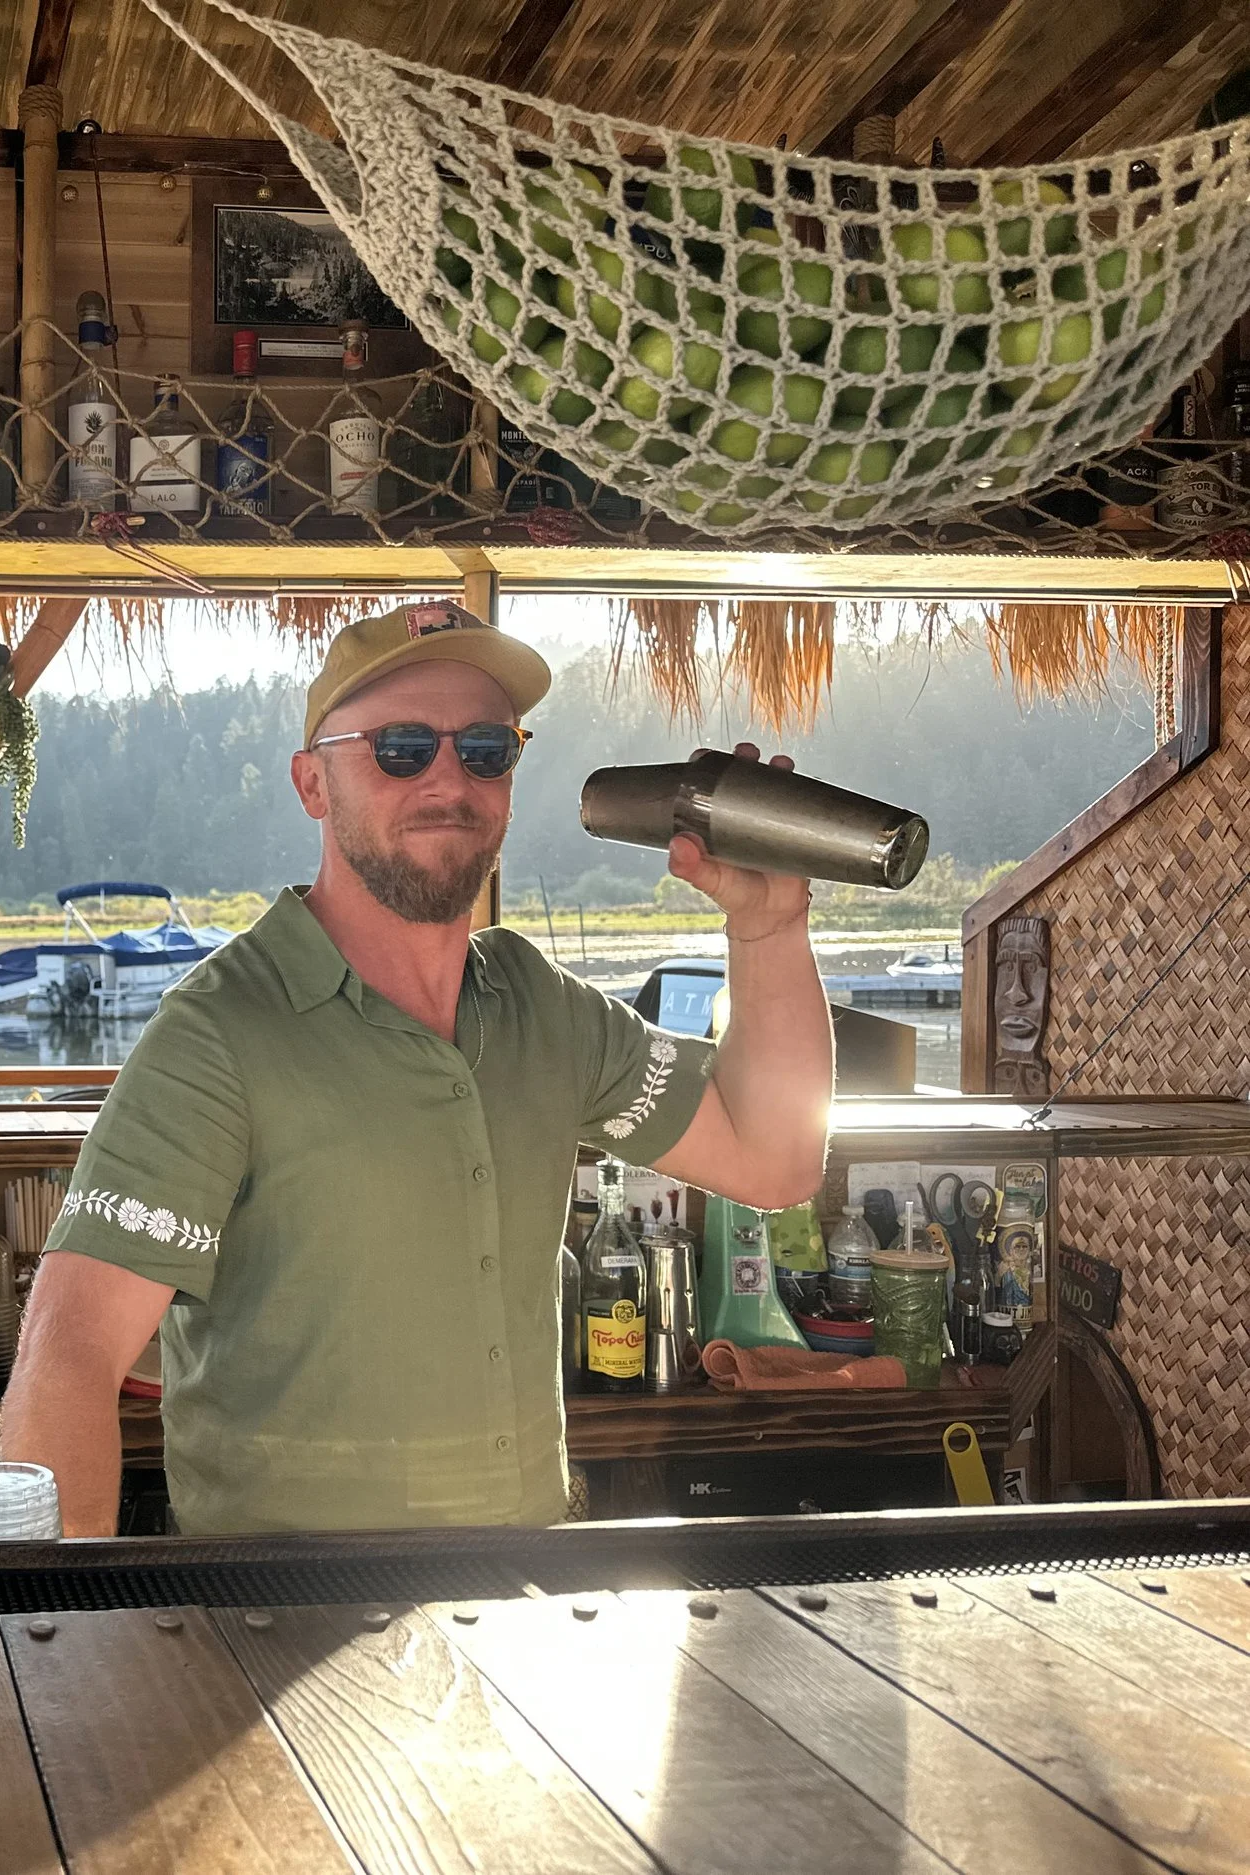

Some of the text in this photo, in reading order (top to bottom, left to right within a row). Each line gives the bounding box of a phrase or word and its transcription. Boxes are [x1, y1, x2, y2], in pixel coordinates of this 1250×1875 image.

[335, 432, 375, 444] OCHO
[151, 493, 177, 503] LALO
[690, 1482, 712, 1495] HK
